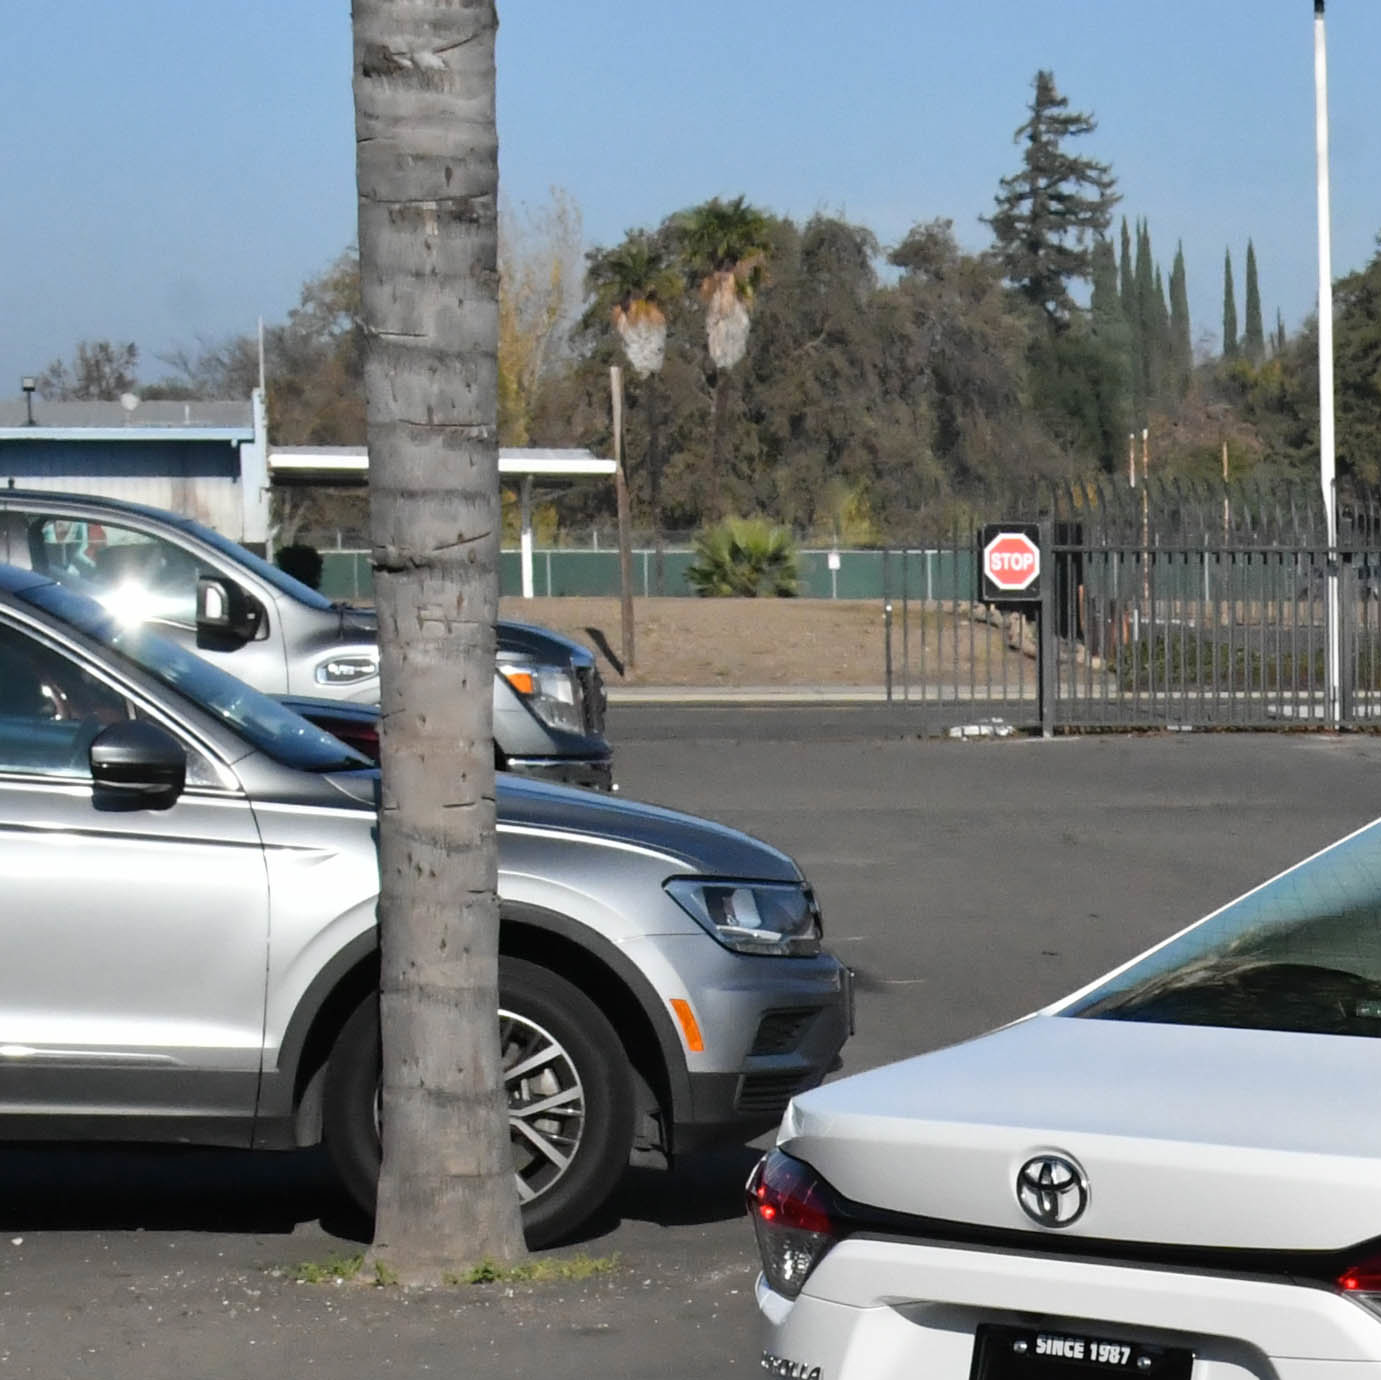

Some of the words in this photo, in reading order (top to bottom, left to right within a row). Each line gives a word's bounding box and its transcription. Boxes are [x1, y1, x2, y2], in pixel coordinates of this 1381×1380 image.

[991, 553, 1033, 571] STOP
[1036, 1337, 1084, 1359] SINCE
[1090, 1344, 1131, 1365] 1987
